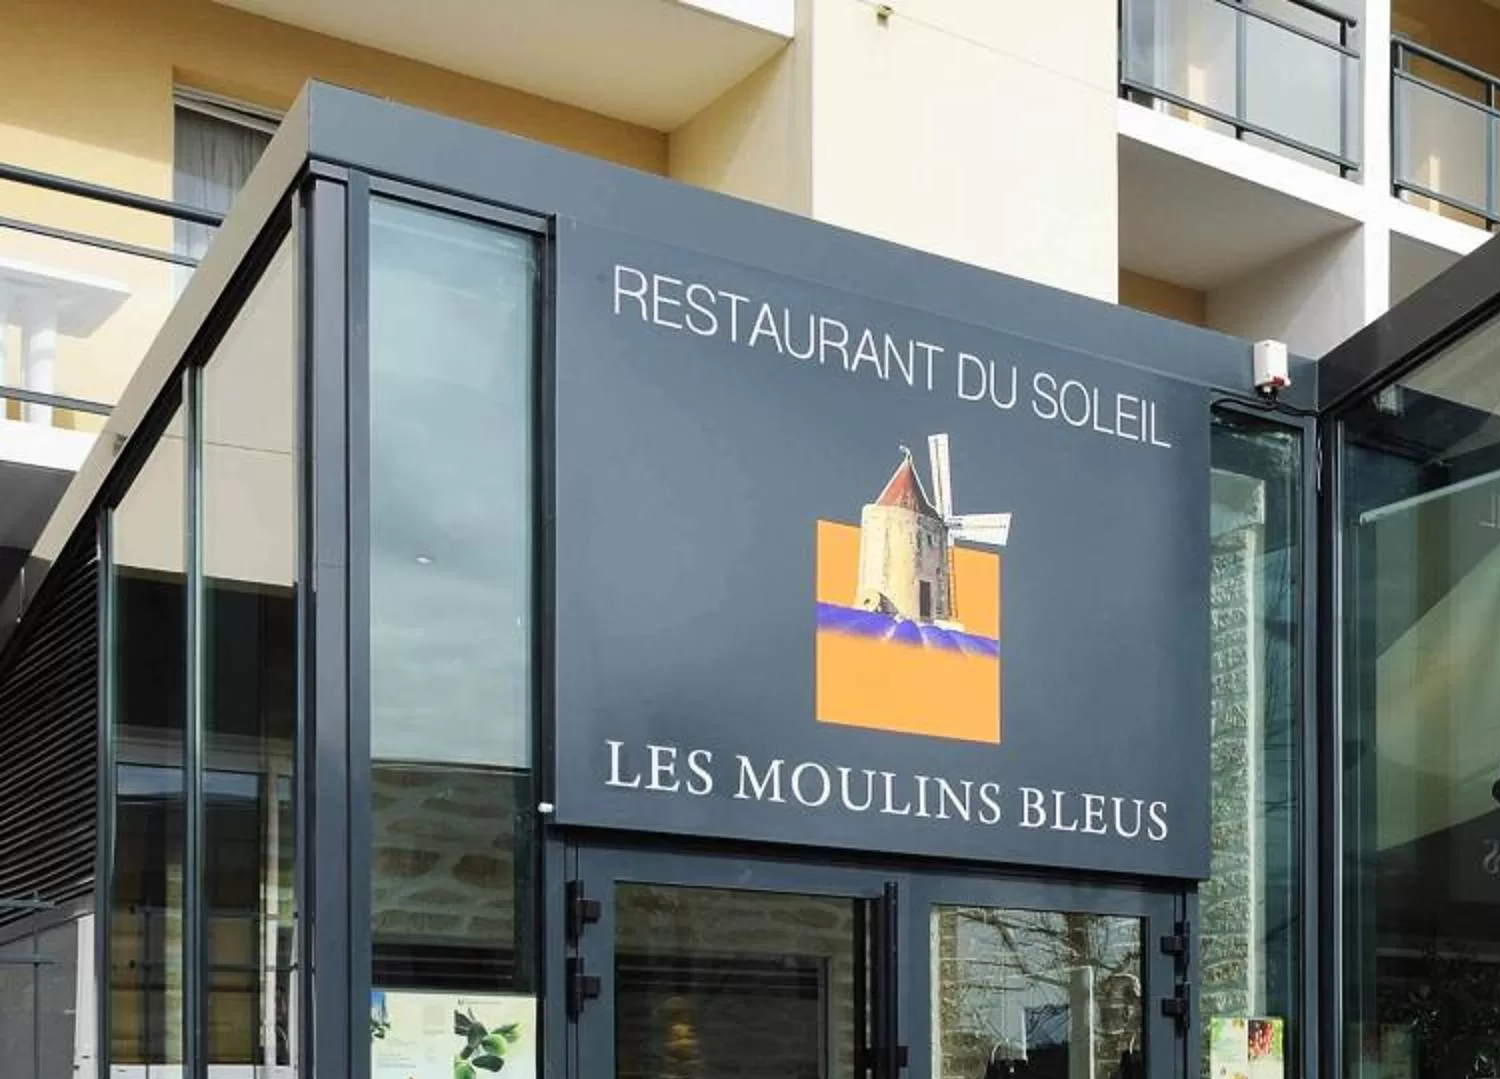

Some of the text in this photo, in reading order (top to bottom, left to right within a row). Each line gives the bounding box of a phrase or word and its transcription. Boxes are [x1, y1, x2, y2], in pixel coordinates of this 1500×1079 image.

[612, 265, 1172, 449] RESTAURANT DU SOLEIL
[605, 740, 1168, 841] LES MOULINS BLEUS
